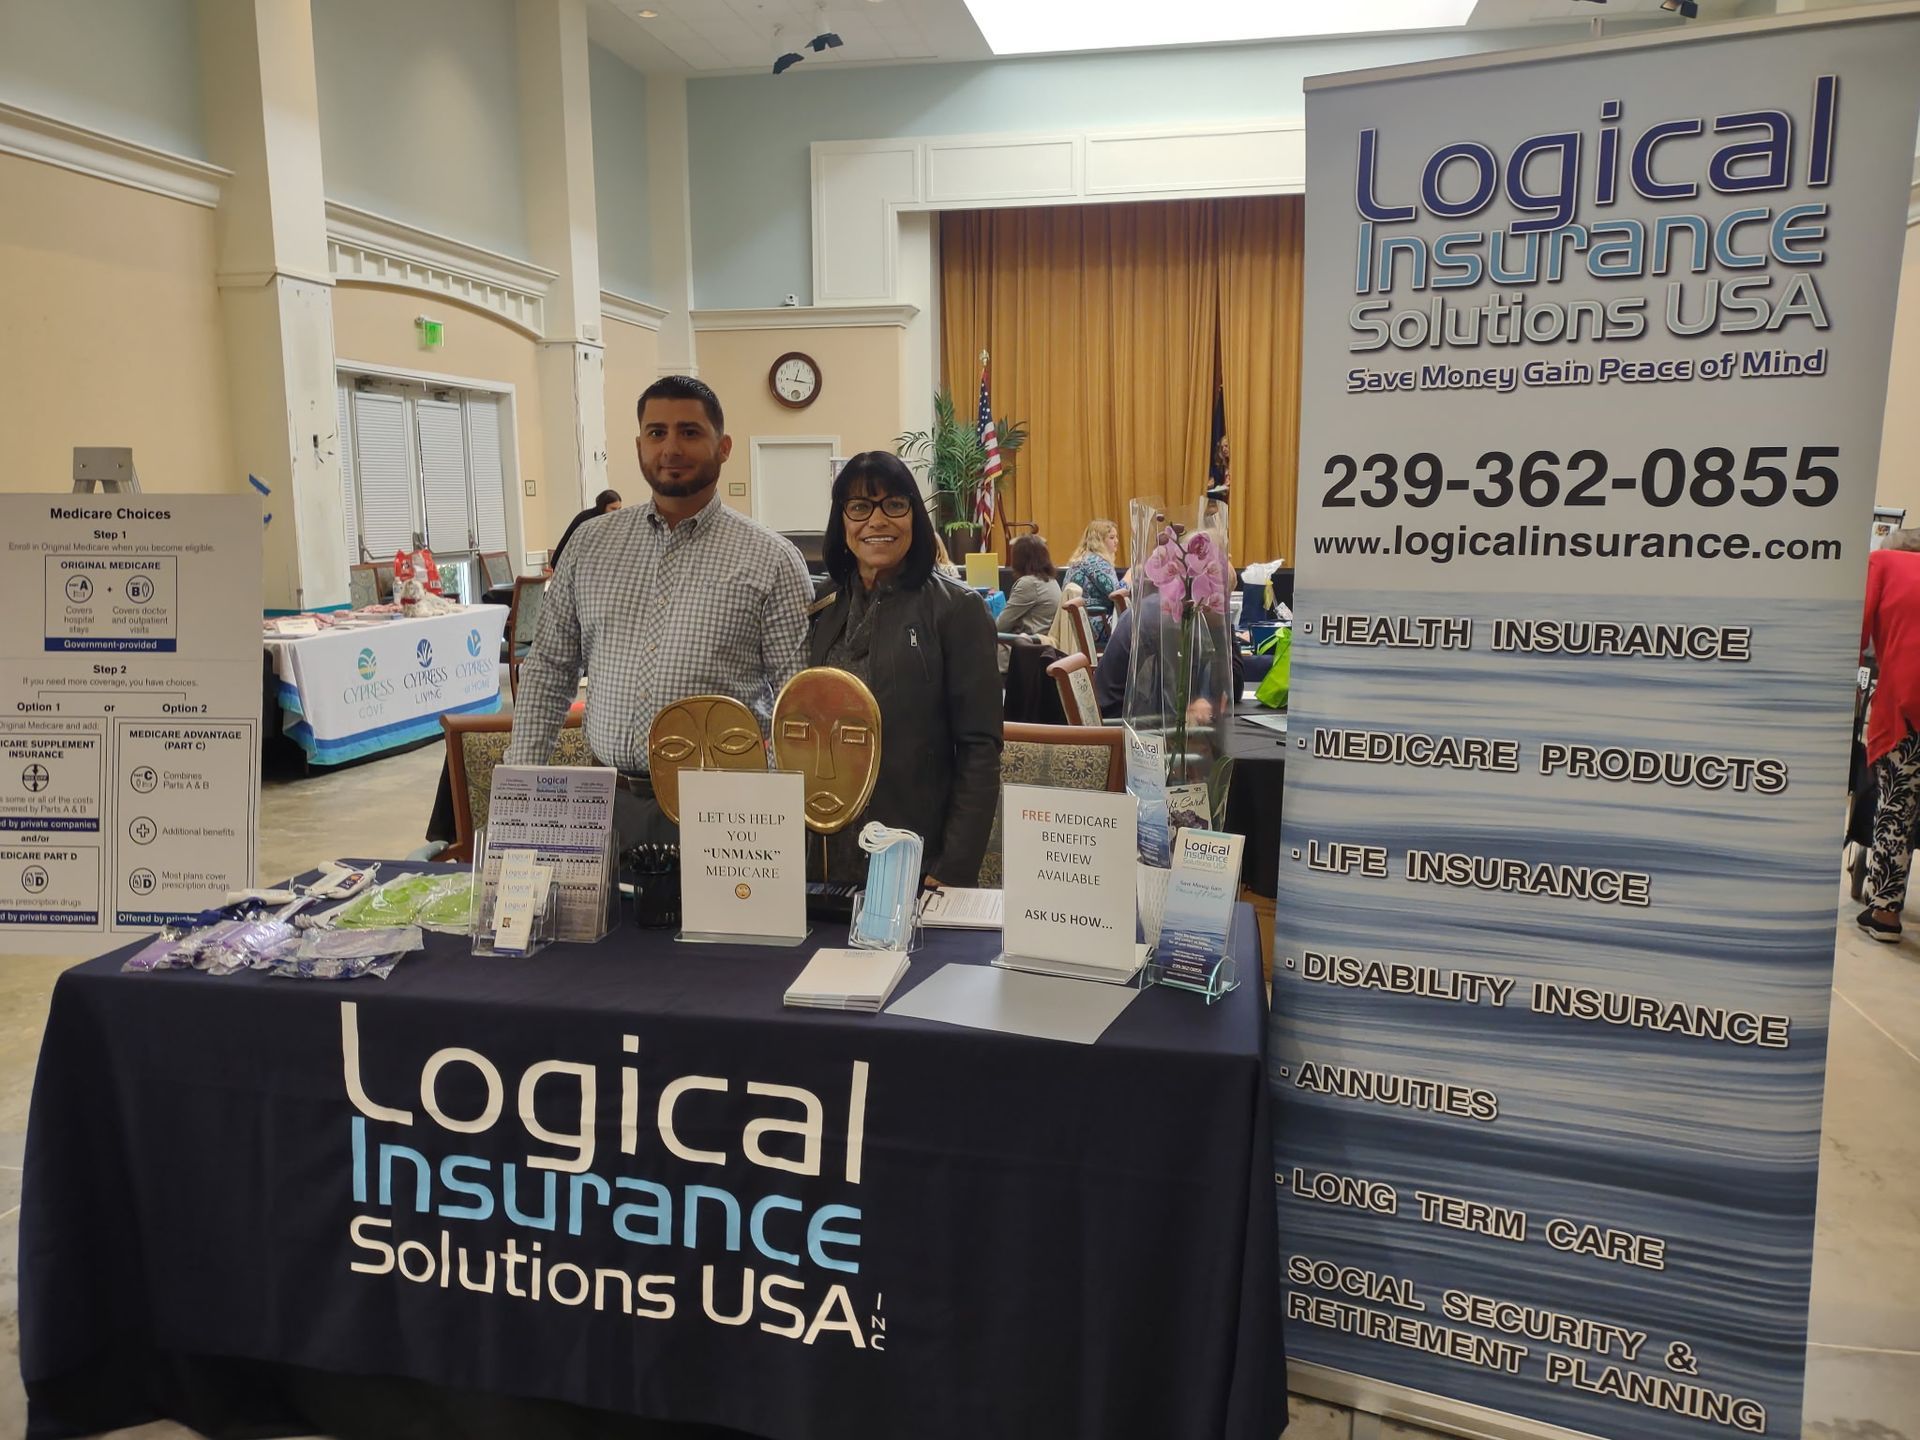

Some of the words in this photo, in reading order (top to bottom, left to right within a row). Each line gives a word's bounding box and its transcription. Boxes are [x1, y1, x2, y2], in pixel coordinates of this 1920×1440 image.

[1354, 75, 1837, 232] Logical
[1355, 203, 1828, 293] Insurance
[1348, 293, 1646, 351] Solutions
[1666, 273, 1829, 335] USA
[1347, 367, 1415, 391] Save
[1420, 365, 1517, 390] Money
[1524, 358, 1590, 385] Gain
[1600, 357, 1690, 382] Peace
[1700, 351, 1735, 377] of
[1741, 347, 1826, 376] Mind
[1322, 445, 1840, 508] 239-362-0855
[50, 508, 112, 519] Medicare
[117, 508, 171, 520] Choices
[94, 530, 118, 540] Step
[122, 531, 126, 539] 1
[8, 542, 30, 551] Enroll
[33, 543, 39, 551] in
[41, 542, 71, 553] Original
[73, 543, 109, 551] Medicare
[112, 544, 133, 552] when
[135, 545, 149, 553] you
[152, 544, 183, 552] become
[1313, 525, 1842, 563] www.logicalinsurance.com
[60, 561, 106, 569] ORIGINAL
[109, 562, 160, 570] MEDICARE
[80, 580, 88, 590] A
[131, 586, 140, 597] B
[66, 606, 93, 615] Covers
[112, 606, 140, 615] Covers
[142, 607, 167, 615] doctor
[64, 615, 95, 625] hospital
[112, 616, 126, 624] and
[128, 616, 168, 626] outpatient
[69, 626, 89, 634] stays
[130, 626, 149, 634] visits
[1319, 615, 1472, 649] HEALTH
[1491, 619, 1751, 660] INSURANCE
[64, 639, 158, 650] Government-provided
[93, 664, 118, 675] Step
[121, 665, 127, 674] 2
[456, 658, 493, 679] CYPRESS
[31, 679, 44, 687] you
[46, 678, 66, 686] need
[90, 679, 128, 688] coverage,
[130, 680, 143, 688] you
[145, 678, 165, 686] have
[166, 678, 198, 687] choices.
[404, 667, 448, 690] CYPRESS
[343, 678, 395, 705] CYPRESS
[415, 688, 442, 704] LIVING
[17, 702, 52, 712] Option
[56, 703, 60, 711] 1
[104, 704, 116, 712] or
[162, 703, 198, 714] Option
[201, 704, 208, 713] 2
[359, 704, 385, 719] COVE
[28, 721, 64, 730] Medicare
[66, 722, 80, 730] and
[129, 730, 181, 738] MEDICARE
[184, 731, 242, 740] ADVANTAGE
[31, 740, 95, 749] SUPPLEMENT
[164, 741, 192, 750] (PART
[195, 742, 206, 750] C)
[9, 750, 64, 758] INSURANCE
[1313, 729, 1519, 771] MEDICARE
[1539, 744, 1788, 792] PRODUCTS
[144, 770, 153, 780] C
[163, 771, 202, 780] Combines
[537, 776, 568, 785] Logical
[163, 781, 184, 790] Parts
[187, 781, 192, 790] A
[195, 781, 200, 790] &
[203, 782, 209, 790] B
[6, 796, 26, 804] some
[38, 795, 46, 803] all
[48, 795, 56, 804] of
[59, 795, 70, 804] the
[72, 796, 94, 804] costs
[30, 804, 38, 814] by
[41, 805, 60, 814] Parts
[64, 805, 69, 813] A
[698, 812, 724, 823] LET
[728, 812, 745, 824] US
[750, 813, 785, 826] HELP
[1022, 809, 1051, 823] FREE
[1055, 813, 1117, 829] MEDICARE
[8, 820, 19, 829] by
[20, 820, 48, 830] private
[51, 820, 97, 830] companies
[162, 827, 200, 836] Additional
[202, 828, 235, 837] benefits
[727, 830, 757, 842] YOU
[1042, 831, 1097, 847] BENEFITS
[1185, 839, 1230, 855] Logical
[44, 852, 68, 860] PART
[71, 853, 78, 861] D
[704, 848, 781, 861] “UNMASK”
[1046, 851, 1092, 865] REVIEW
[1184, 850, 1228, 863] Insurance
[183, 872, 203, 881] plans
[706, 866, 780, 879] MEDICARE
[1037, 870, 1100, 886] AVAILABLE
[1308, 840, 1387, 877] LIFE
[1406, 850, 1650, 905] INSURANCE
[36, 876, 44, 886] D
[143, 878, 152, 888] D
[162, 880, 205, 890] prescription
[207, 881, 230, 891] drugs
[16, 899, 58, 907] prescription
[61, 899, 81, 907] drugs
[8, 912, 18, 922] by
[20, 913, 48, 923] private
[50, 913, 96, 923] companies
[118, 913, 151, 922] Offered
[154, 914, 164, 924] by
[1024, 909, 1047, 921] ASK
[1051, 911, 1067, 924] US
[1070, 915, 1113, 930] HOW...
[1302, 951, 1515, 1006] DISABILITY
[1532, 982, 1790, 1048] INSURANCE
[341, 1001, 869, 1184] Logical
[1294, 1061, 1498, 1120] ANNUITIES
[351, 1116, 862, 1274] Insurance
[1292, 1168, 1397, 1214] LONG
[1415, 1191, 1527, 1241] TERM
[1546, 1219, 1665, 1269] CARE
[350, 1215, 676, 1319] Solutions
[702, 1264, 867, 1349] USA
[1288, 1255, 1425, 1311] SOCIAL
[1443, 1290, 1646, 1360] SECURITY
[1665, 1343, 1698, 1375] &
[871, 1292, 886, 1351] INC
[1287, 1294, 1527, 1374] RETIREMENT
[1546, 1355, 1766, 1433] PLANNING
